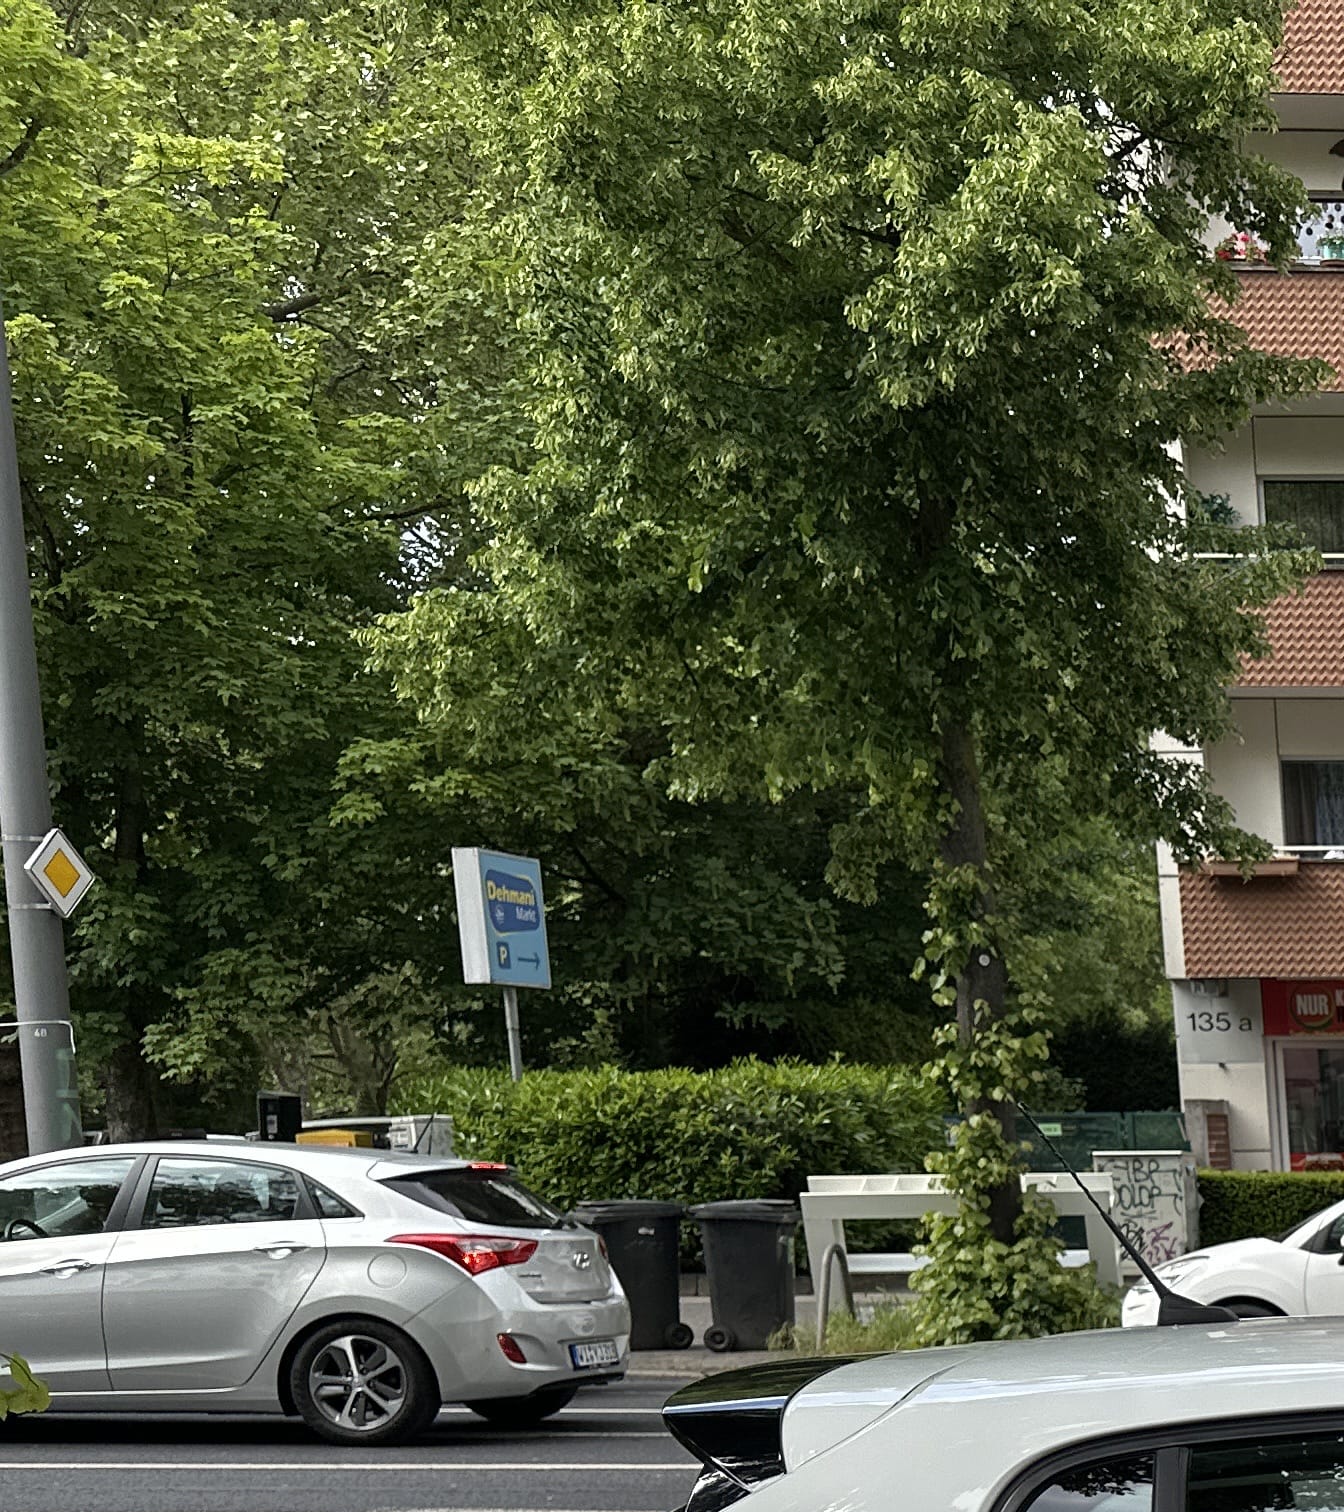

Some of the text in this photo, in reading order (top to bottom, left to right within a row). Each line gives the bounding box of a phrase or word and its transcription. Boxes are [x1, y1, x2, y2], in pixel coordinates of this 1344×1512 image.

[500, 946, 508, 964] P
[1296, 995, 1328, 1016] NUR
[1187, 1012, 1252, 1031] 135 a
